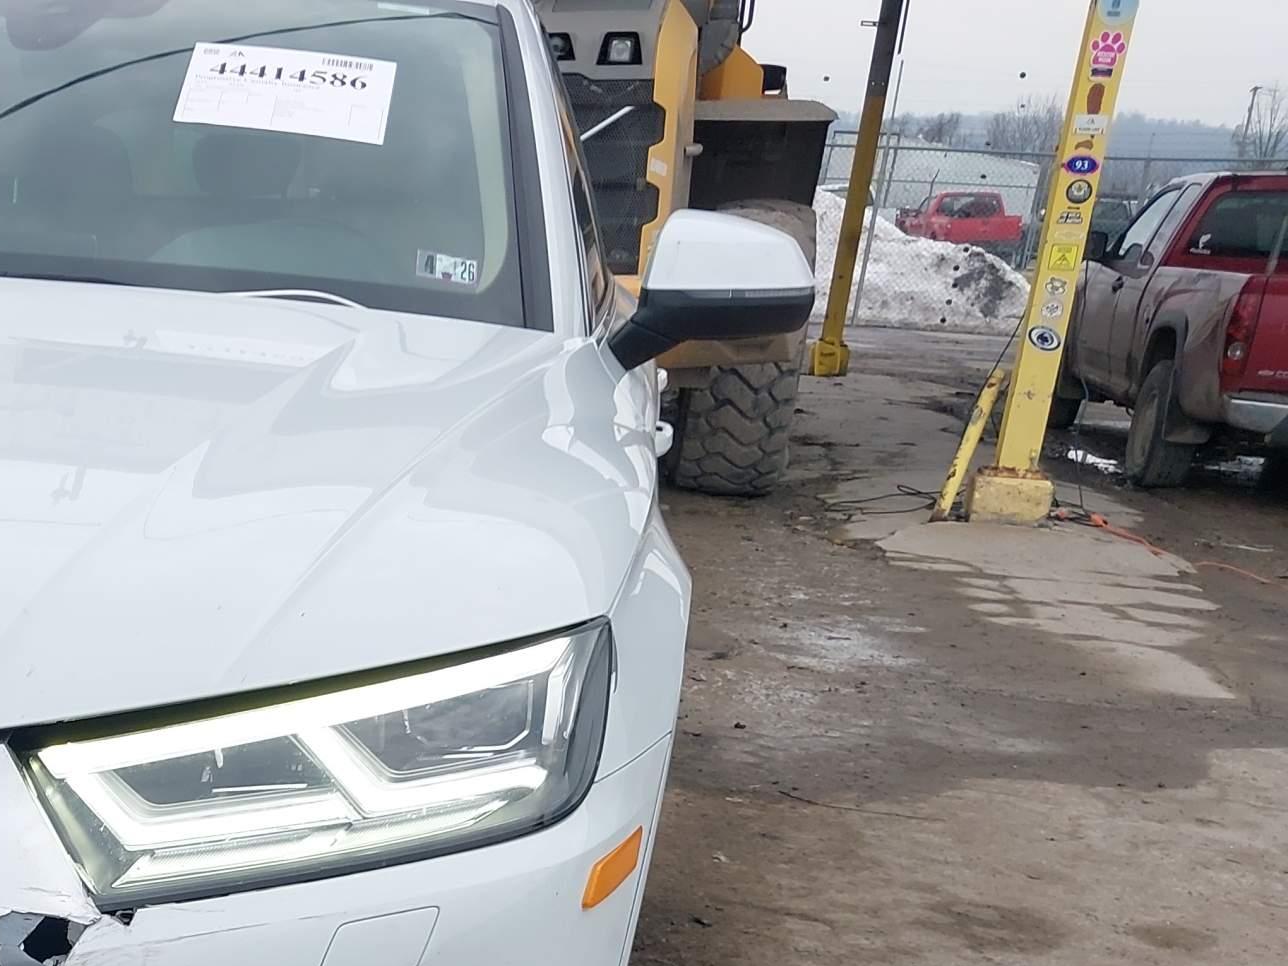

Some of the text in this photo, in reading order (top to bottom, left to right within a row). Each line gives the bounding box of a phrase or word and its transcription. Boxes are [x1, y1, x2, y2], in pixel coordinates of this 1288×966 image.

[209, 61, 368, 91] 44414586
[1075, 159, 1089, 171] 93
[460, 260, 475, 282] 26
